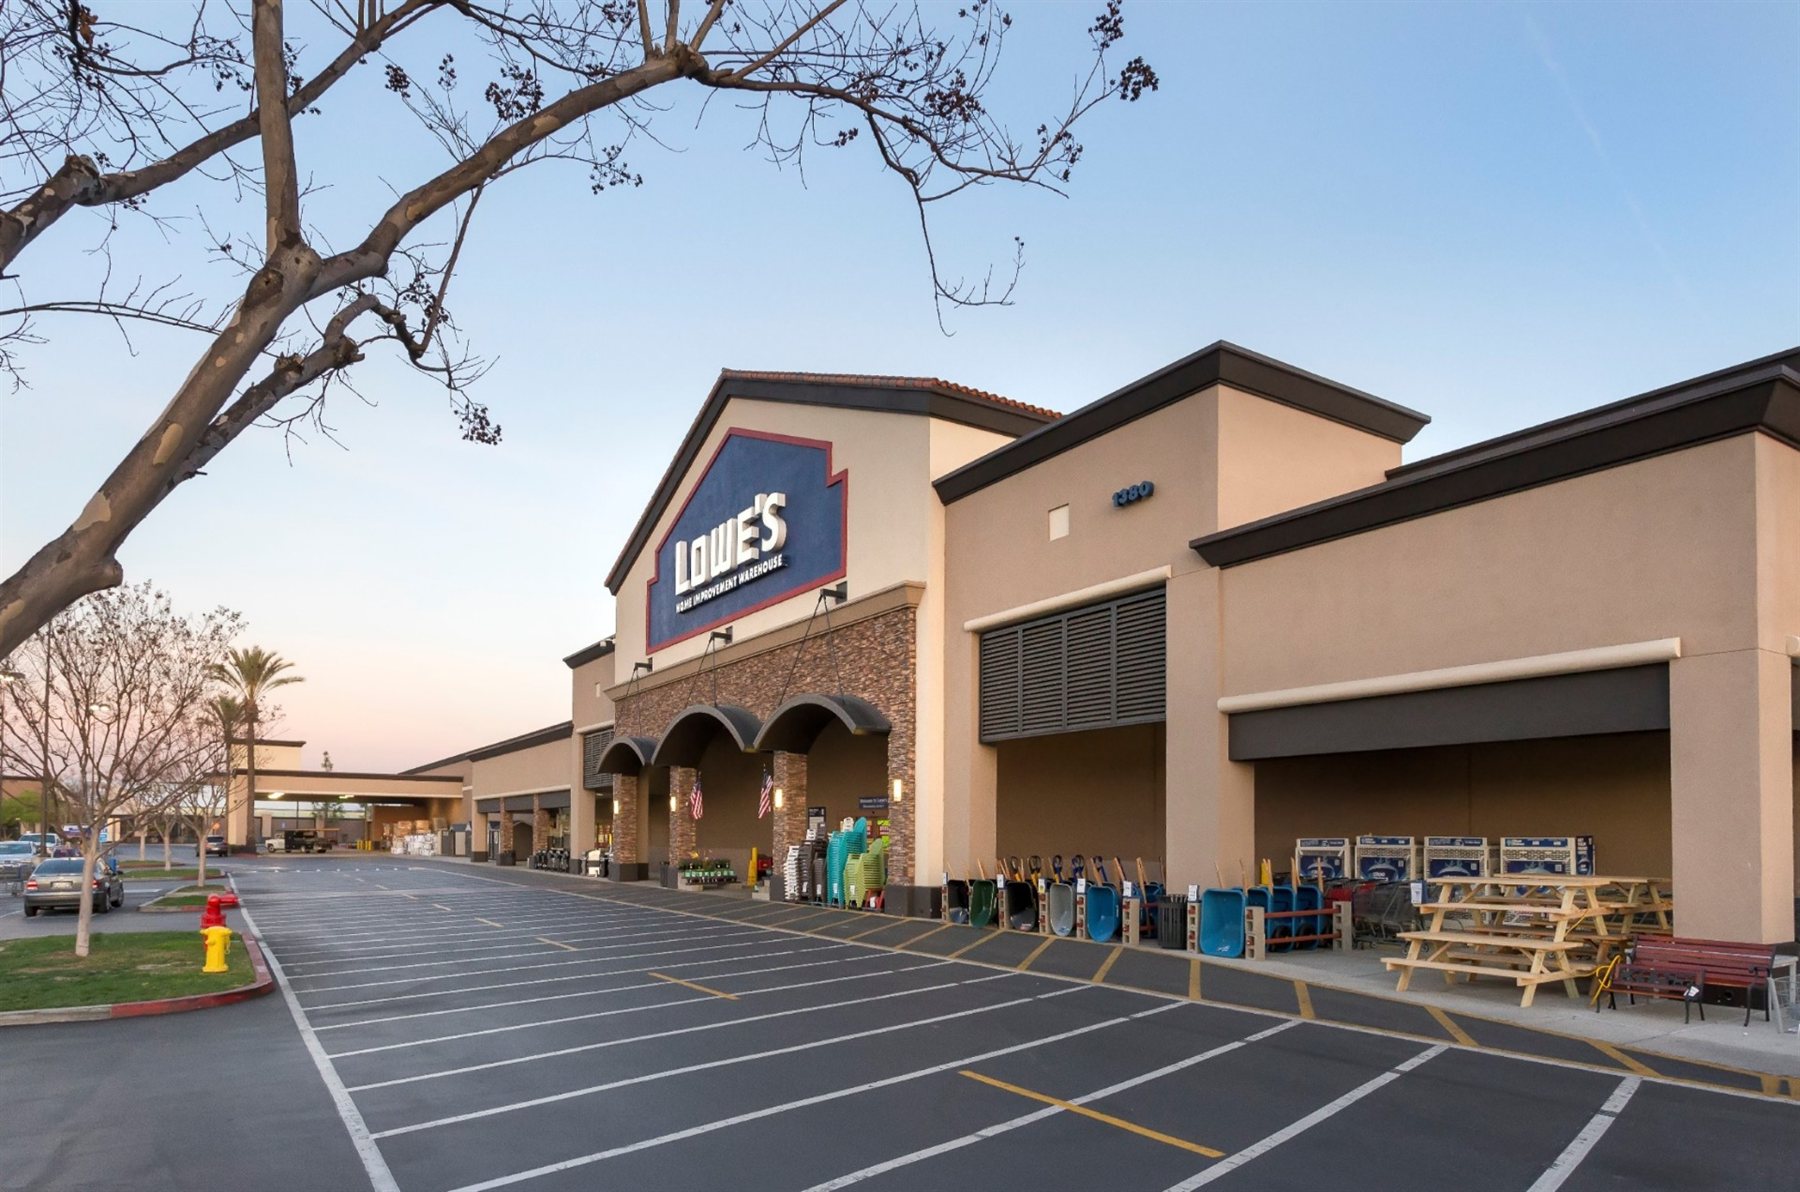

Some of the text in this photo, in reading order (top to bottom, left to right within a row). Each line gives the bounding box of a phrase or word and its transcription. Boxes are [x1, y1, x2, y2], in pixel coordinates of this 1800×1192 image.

[1112, 481, 1154, 509] 1380
[675, 492, 787, 596] LOWE'S
[676, 553, 783, 614] HOME IMPROVEMENT WAREHOUSE
